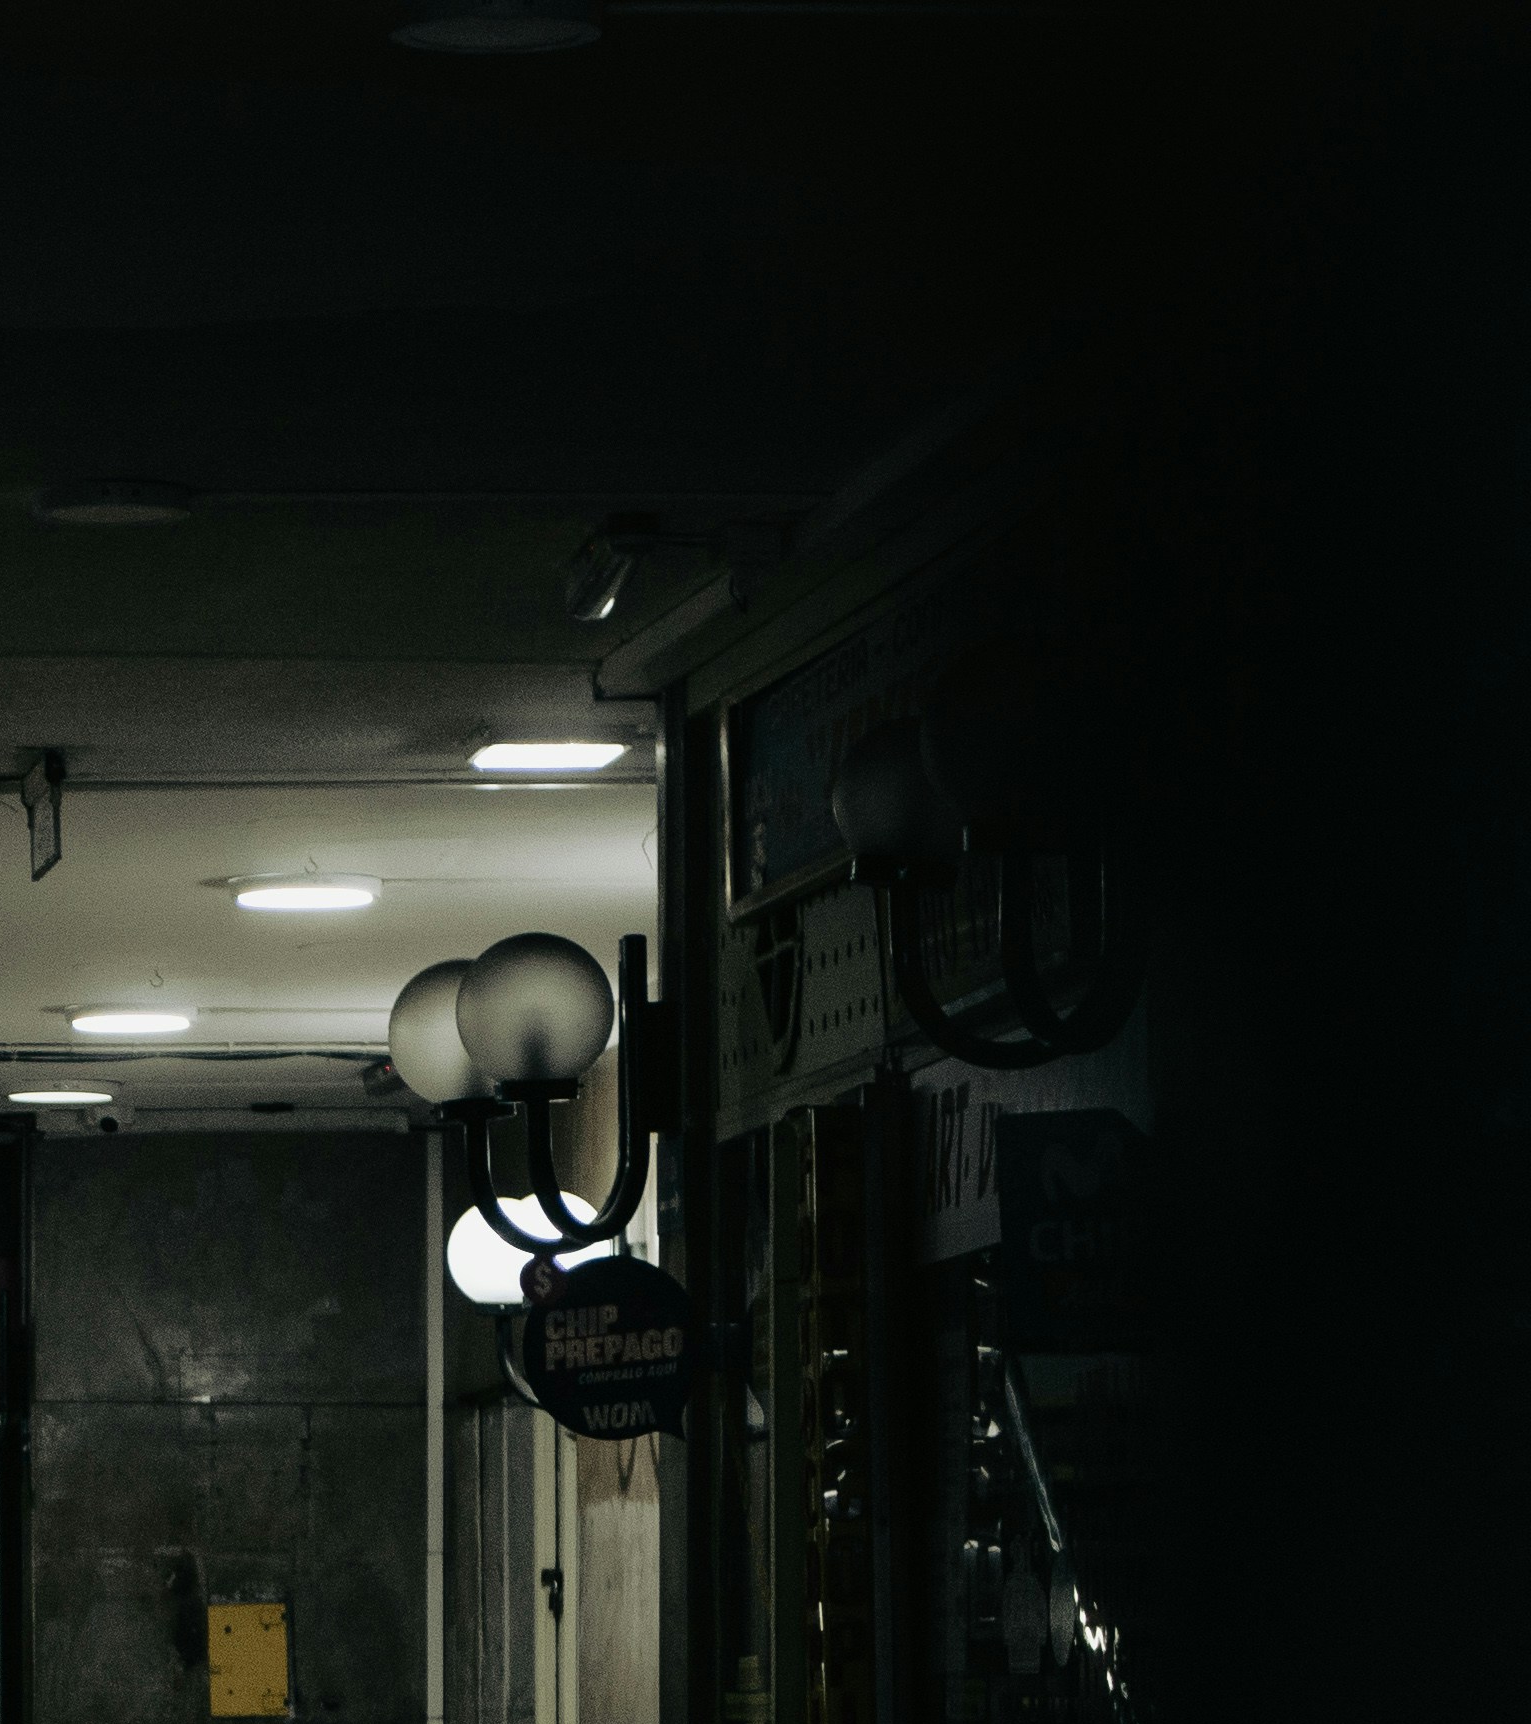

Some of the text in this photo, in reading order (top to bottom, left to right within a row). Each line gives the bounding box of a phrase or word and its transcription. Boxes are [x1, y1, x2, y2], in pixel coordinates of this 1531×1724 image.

[545, 1304, 619, 1341] CHIP
[545, 1326, 684, 1371] PREPAGO
[582, 1400, 657, 1431] WOM
